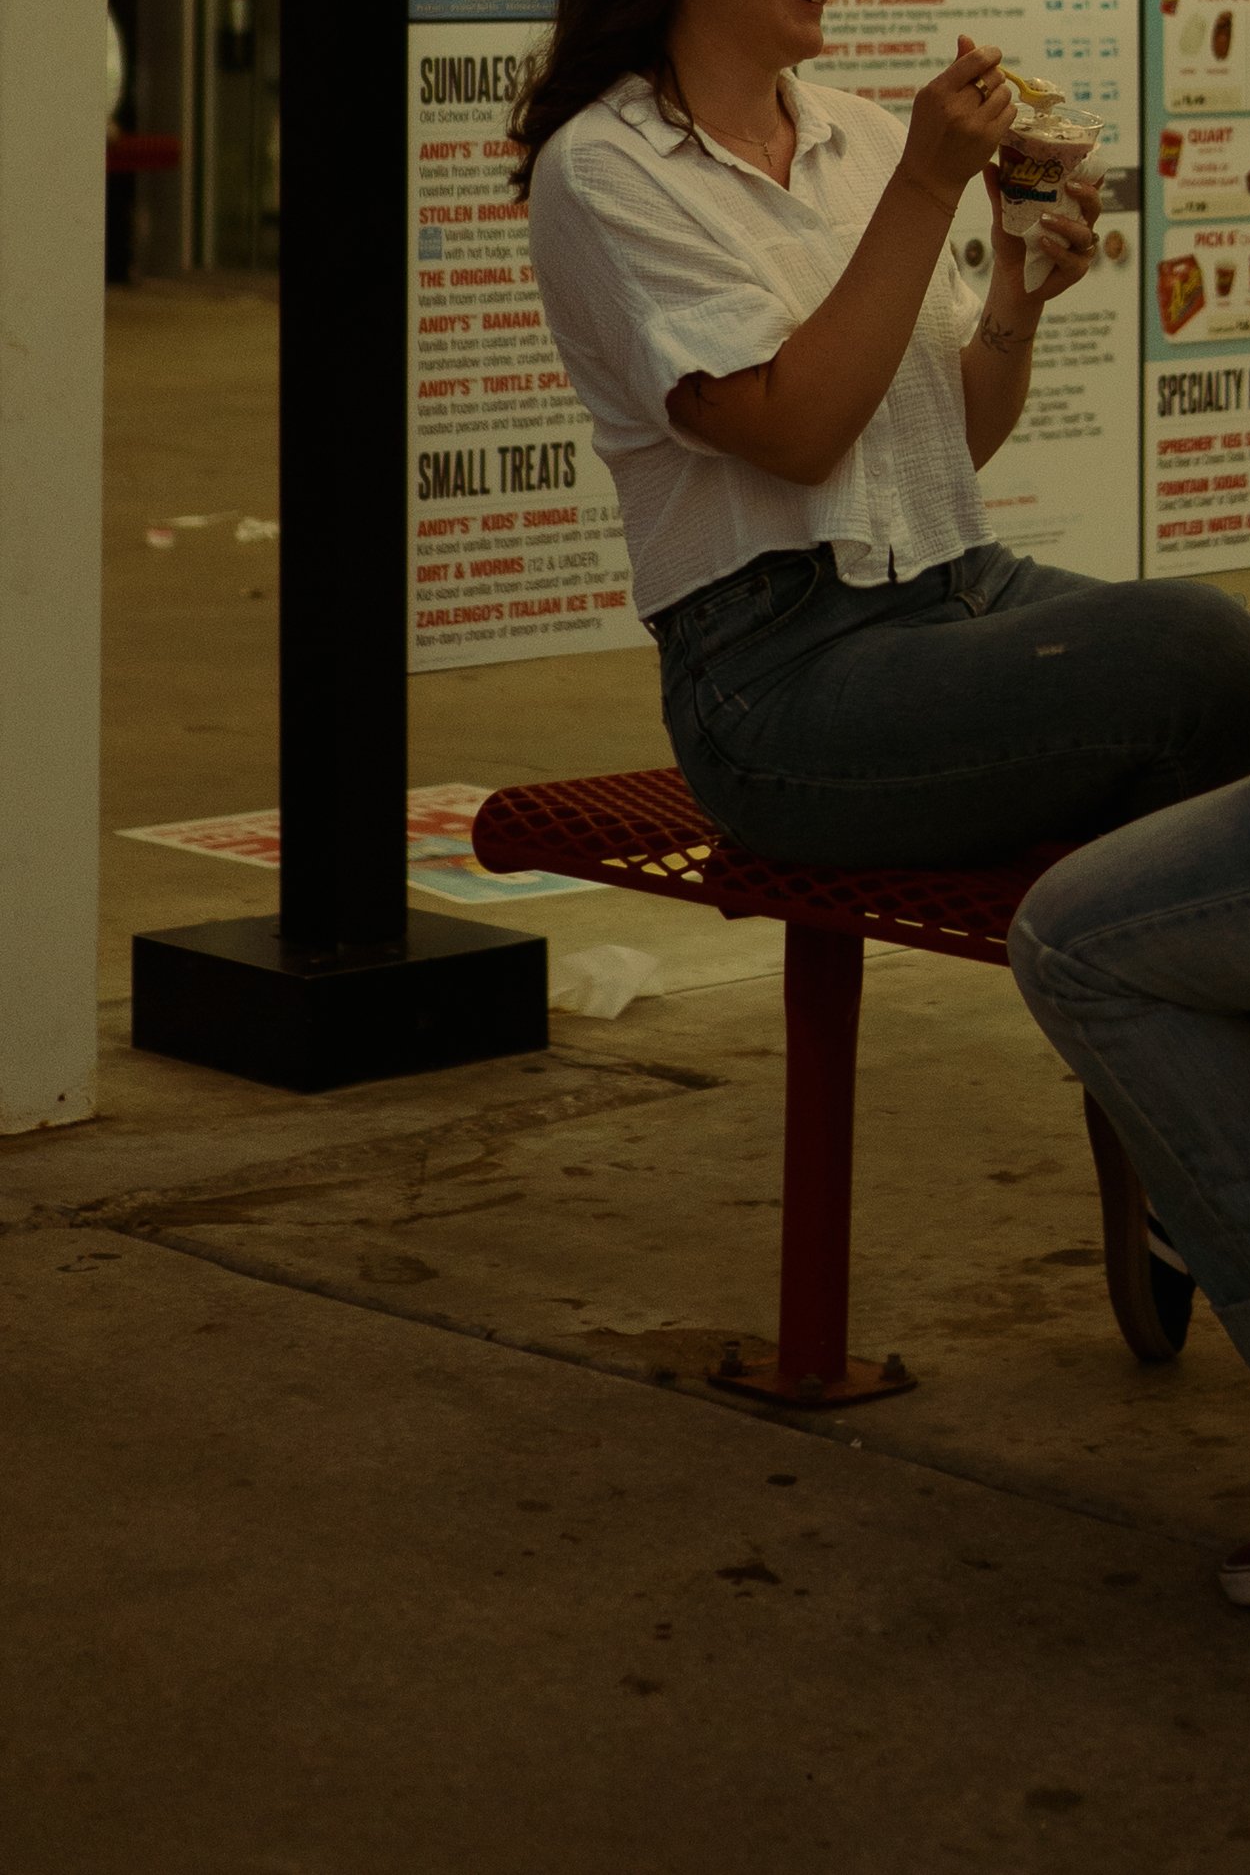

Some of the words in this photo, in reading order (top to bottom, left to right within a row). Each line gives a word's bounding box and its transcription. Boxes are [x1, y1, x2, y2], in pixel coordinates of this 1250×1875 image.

[420, 56, 516, 105] SUNDAES
[1188, 127, 1233, 145] QUART
[420, 141, 471, 160] ANDY'S
[419, 205, 473, 224] STOLEN
[419, 270, 445, 288] THE
[451, 268, 515, 287] ORIGINAL
[418, 314, 471, 334] ANDY'S
[482, 311, 541, 330] BANANA
[418, 378, 470, 398] ANDY'S
[481, 374, 532, 394] TURTLE
[538, 372, 572, 390] SPLI
[1157, 366, 1245, 417] SPECIALTY
[418, 448, 491, 501] SMALL
[497, 440, 576, 494] TREATS
[417, 516, 470, 537] ANDY'S
[523, 506, 578, 528] SUNDAE
[417, 563, 449, 583] DIRT
[454, 561, 465, 580] &
[416, 603, 504, 629] ZARLENGO'S
[509, 597, 561, 619] ITALIAN
[566, 593, 588, 612] ICE
